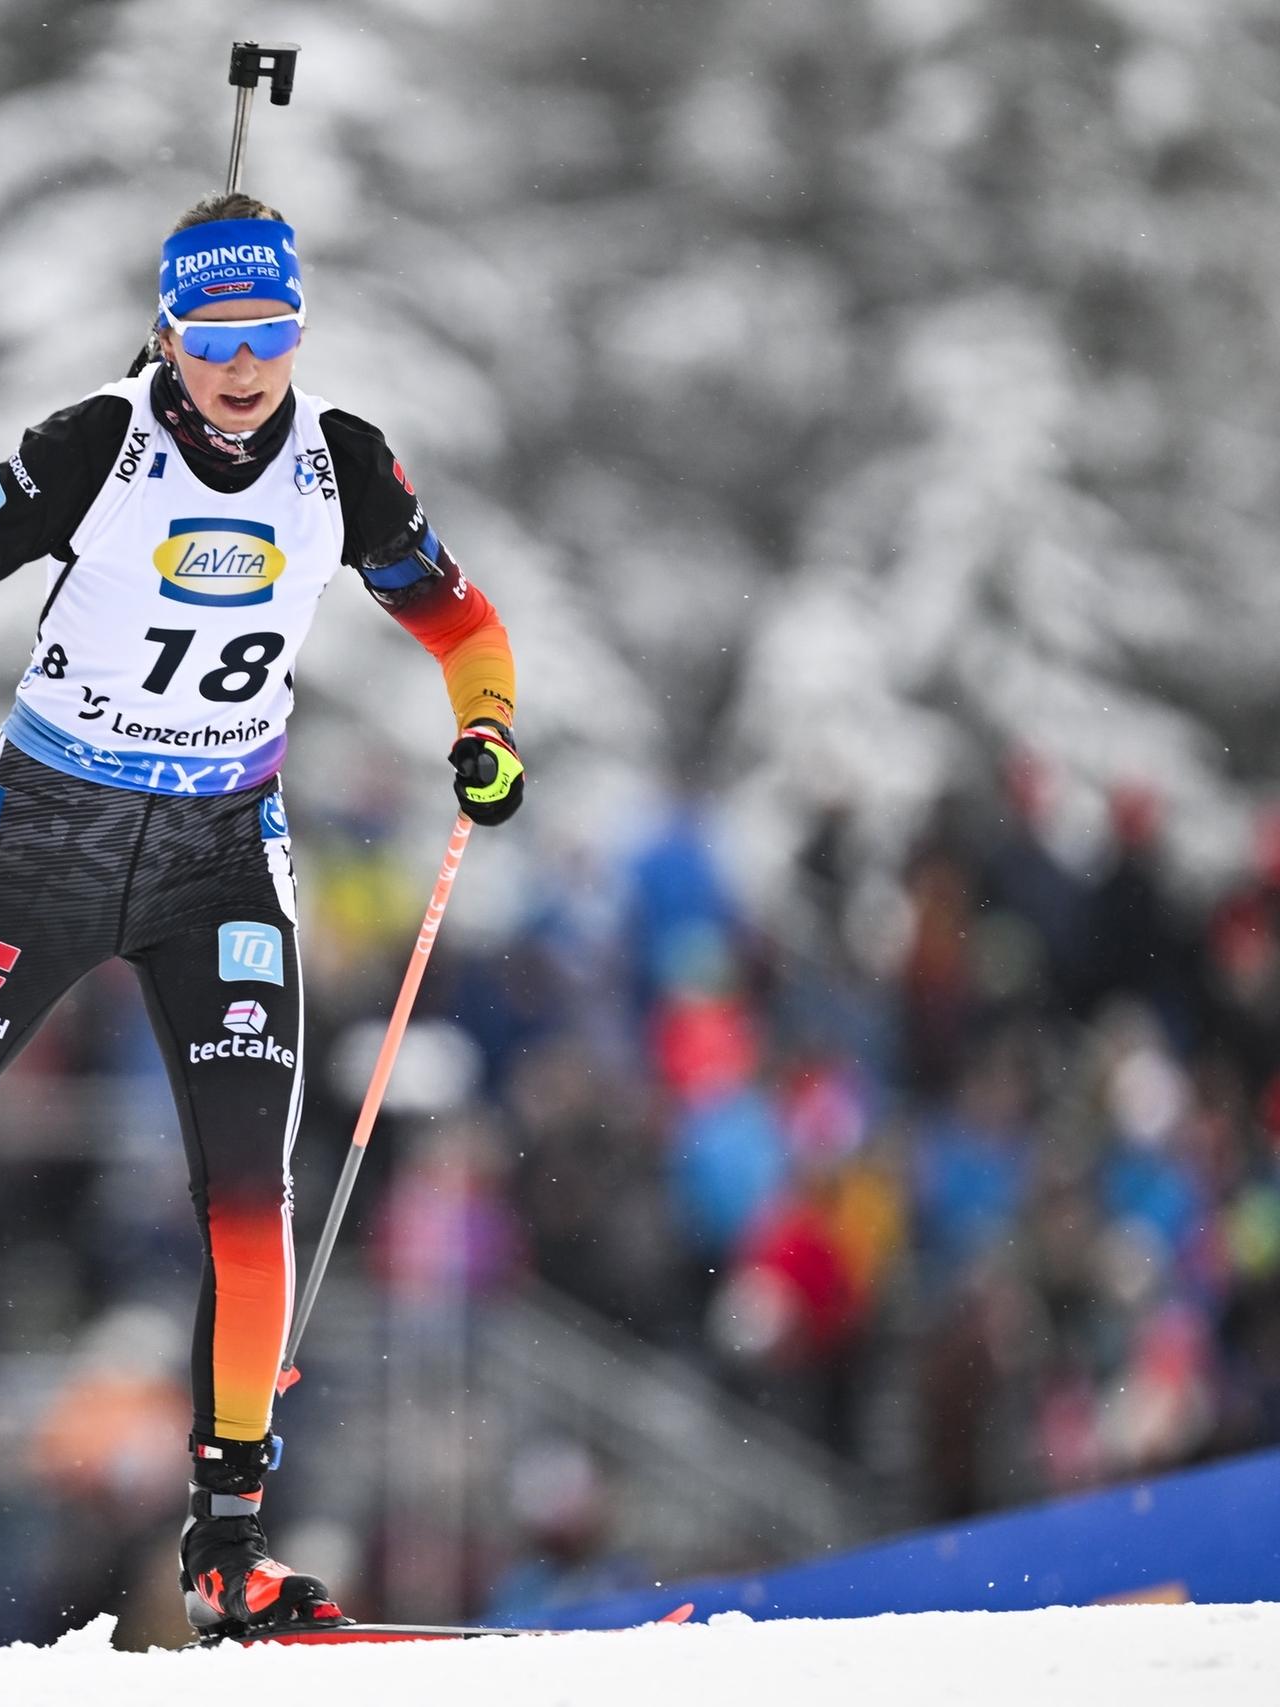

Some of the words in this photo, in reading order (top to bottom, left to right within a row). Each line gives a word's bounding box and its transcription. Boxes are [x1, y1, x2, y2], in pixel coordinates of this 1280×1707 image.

[175, 245, 280, 278] ERDINGER
[178, 266, 280, 292] ALKOHOLFREI
[306, 448, 336, 501] JOKA
[141, 626, 286, 703] 18
[111, 712, 270, 748] Lenzerheide
[229, 930, 275, 977] TQ
[189, 1034, 296, 1069] tectake
